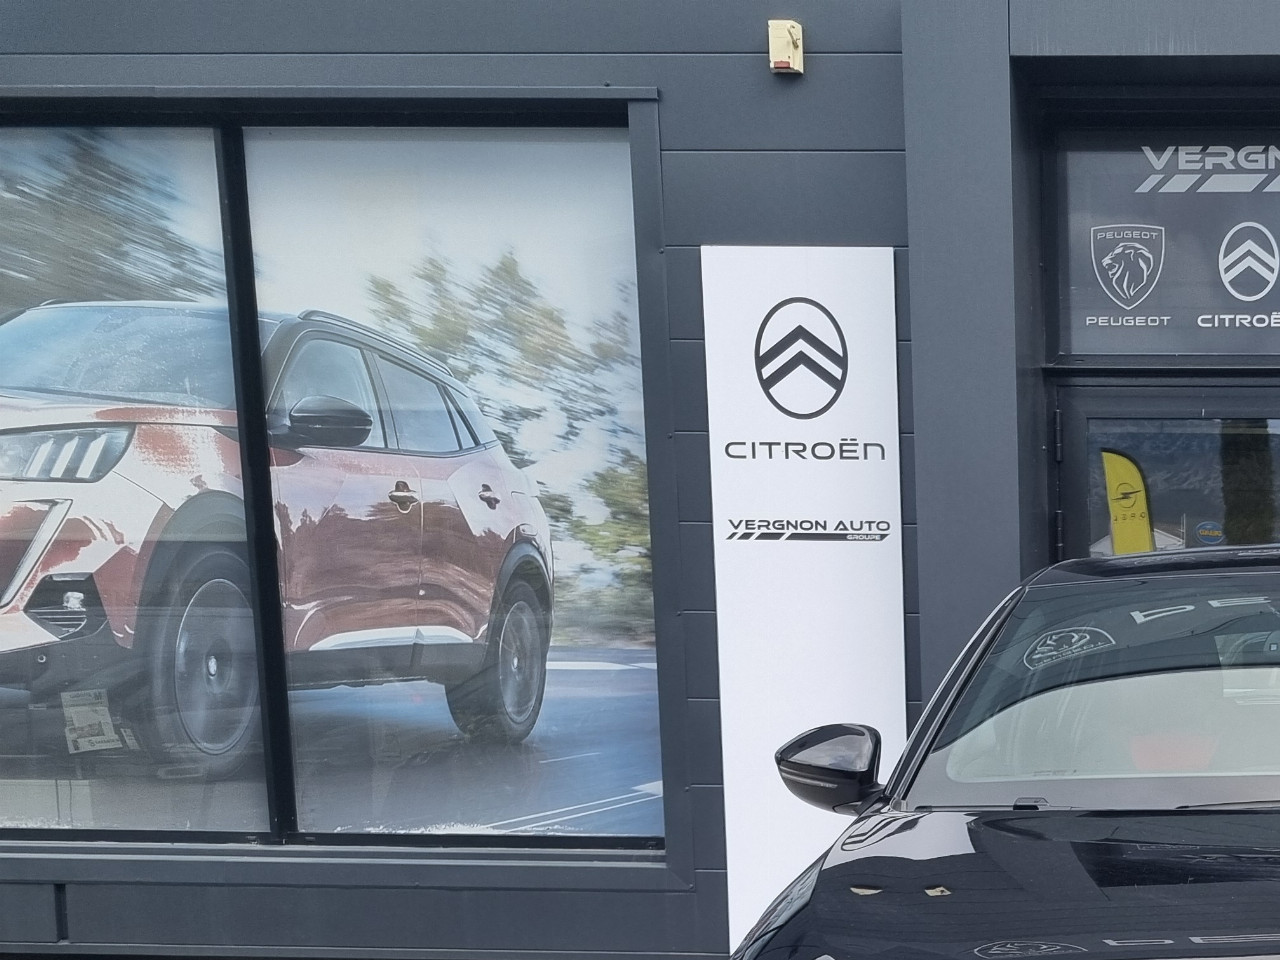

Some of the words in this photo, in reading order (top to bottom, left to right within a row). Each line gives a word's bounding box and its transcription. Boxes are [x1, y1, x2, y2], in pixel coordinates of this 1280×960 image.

[1097, 230, 1159, 241] PEUGEOT
[1086, 315, 1172, 326] PEUGEOT
[728, 519, 827, 532] VERGNON
[834, 520, 891, 532] AUTO
